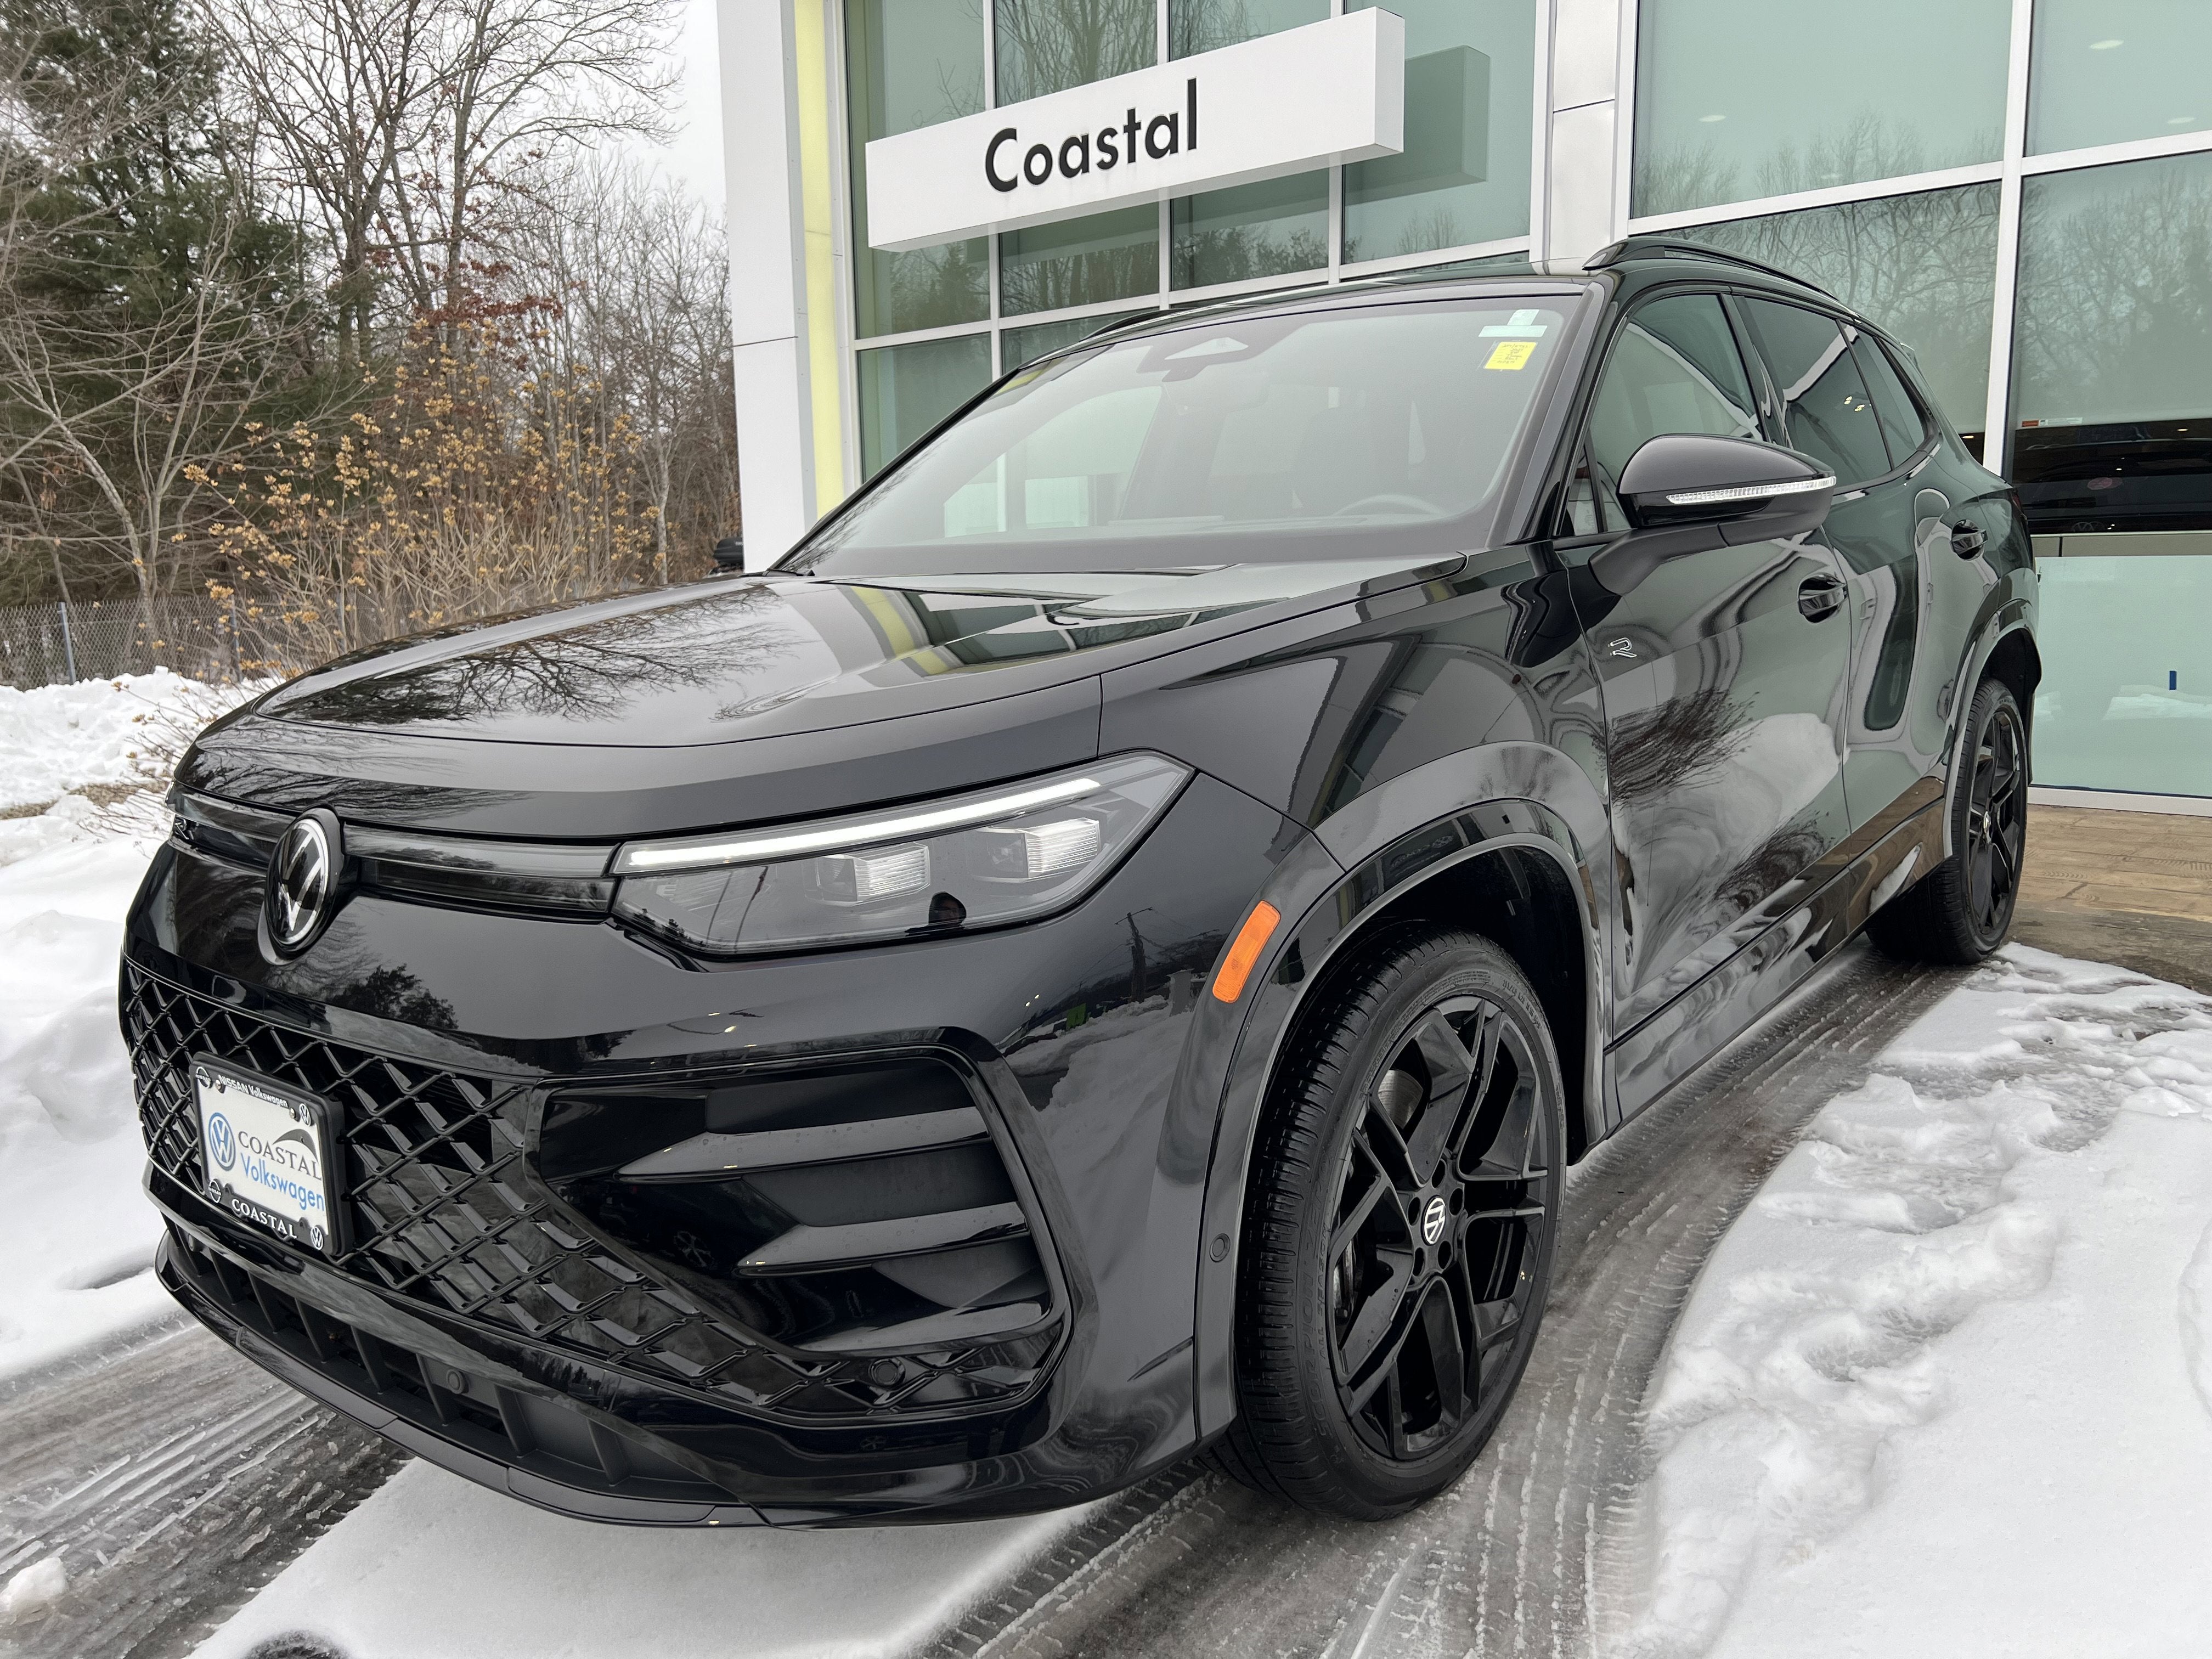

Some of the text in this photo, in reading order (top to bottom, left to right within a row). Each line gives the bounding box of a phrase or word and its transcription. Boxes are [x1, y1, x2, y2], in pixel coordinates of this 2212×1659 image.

[985, 77, 1197, 193] Coastal
[218, 1074, 250, 1094] NISSAN
[248, 1084, 289, 1108] Volkswagen
[208, 1112, 236, 1171] VW
[238, 1131, 322, 1181] COASTAL
[240, 1153, 325, 1211] Volkswagen
[232, 1198, 298, 1239] COASTAL
[1301, 1271, 1333, 1437] SCORPION
